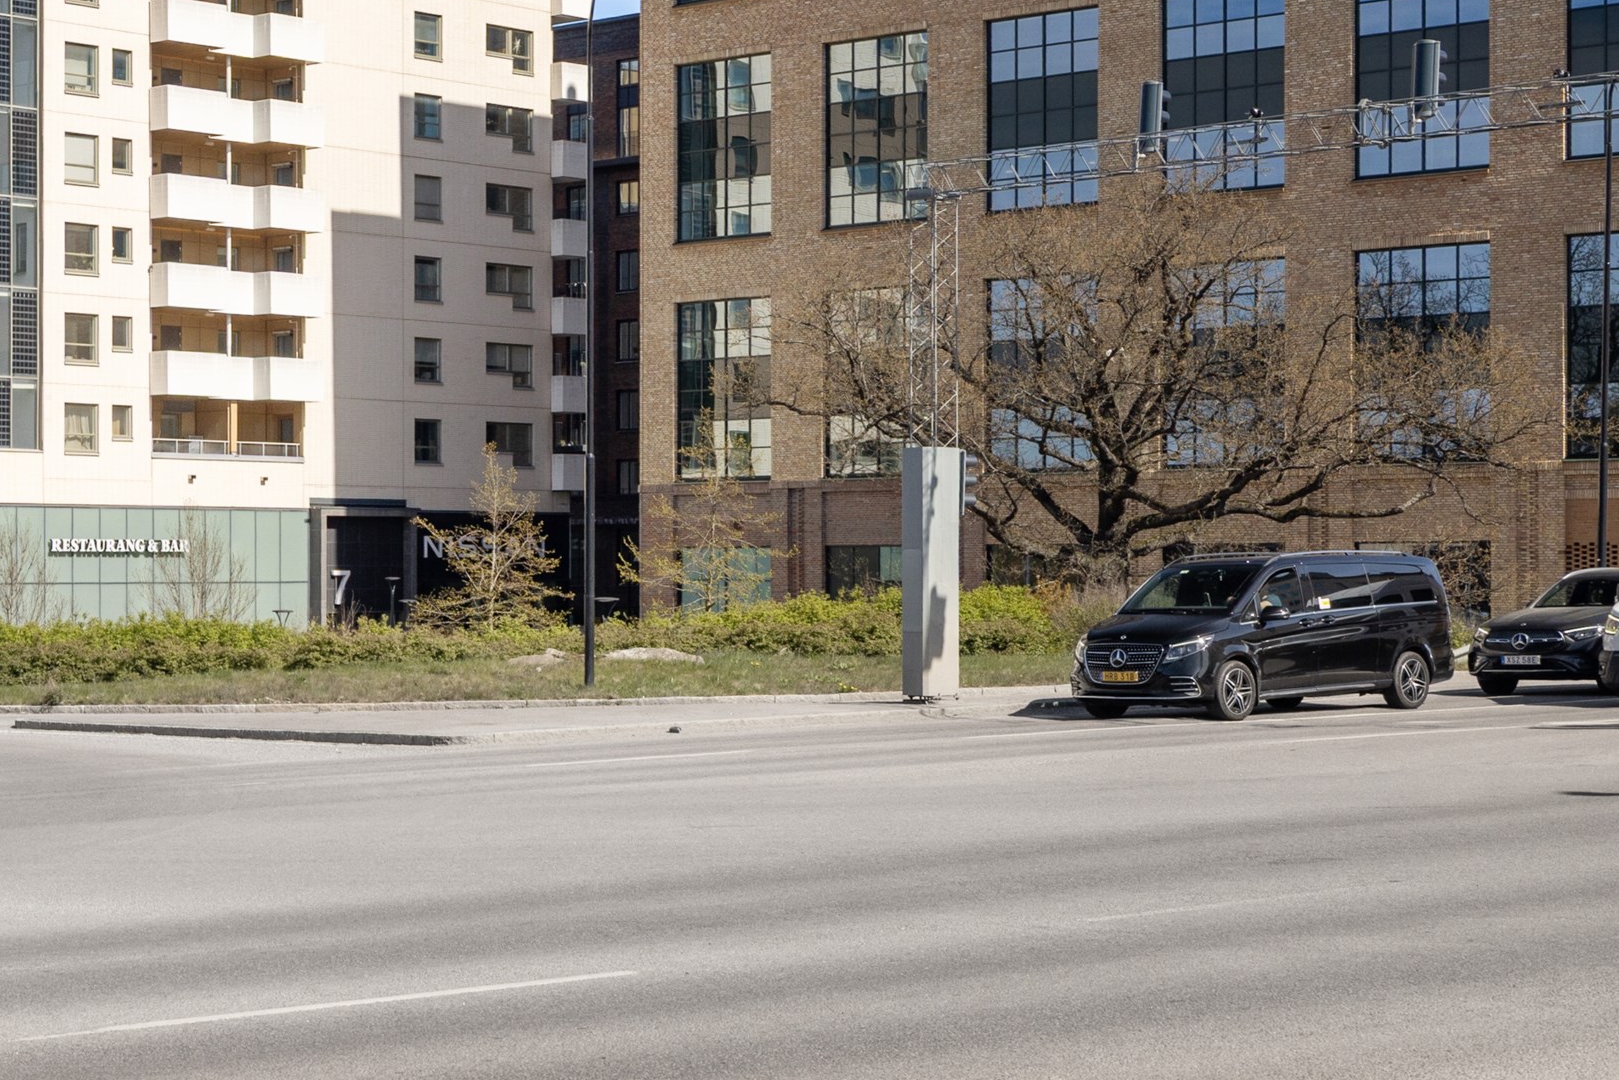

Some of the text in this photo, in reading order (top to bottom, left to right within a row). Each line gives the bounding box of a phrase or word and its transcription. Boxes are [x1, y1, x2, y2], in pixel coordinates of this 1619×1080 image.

[50, 538, 190, 553] RESTAURANG & BAR
[331, 570, 351, 605] 7
